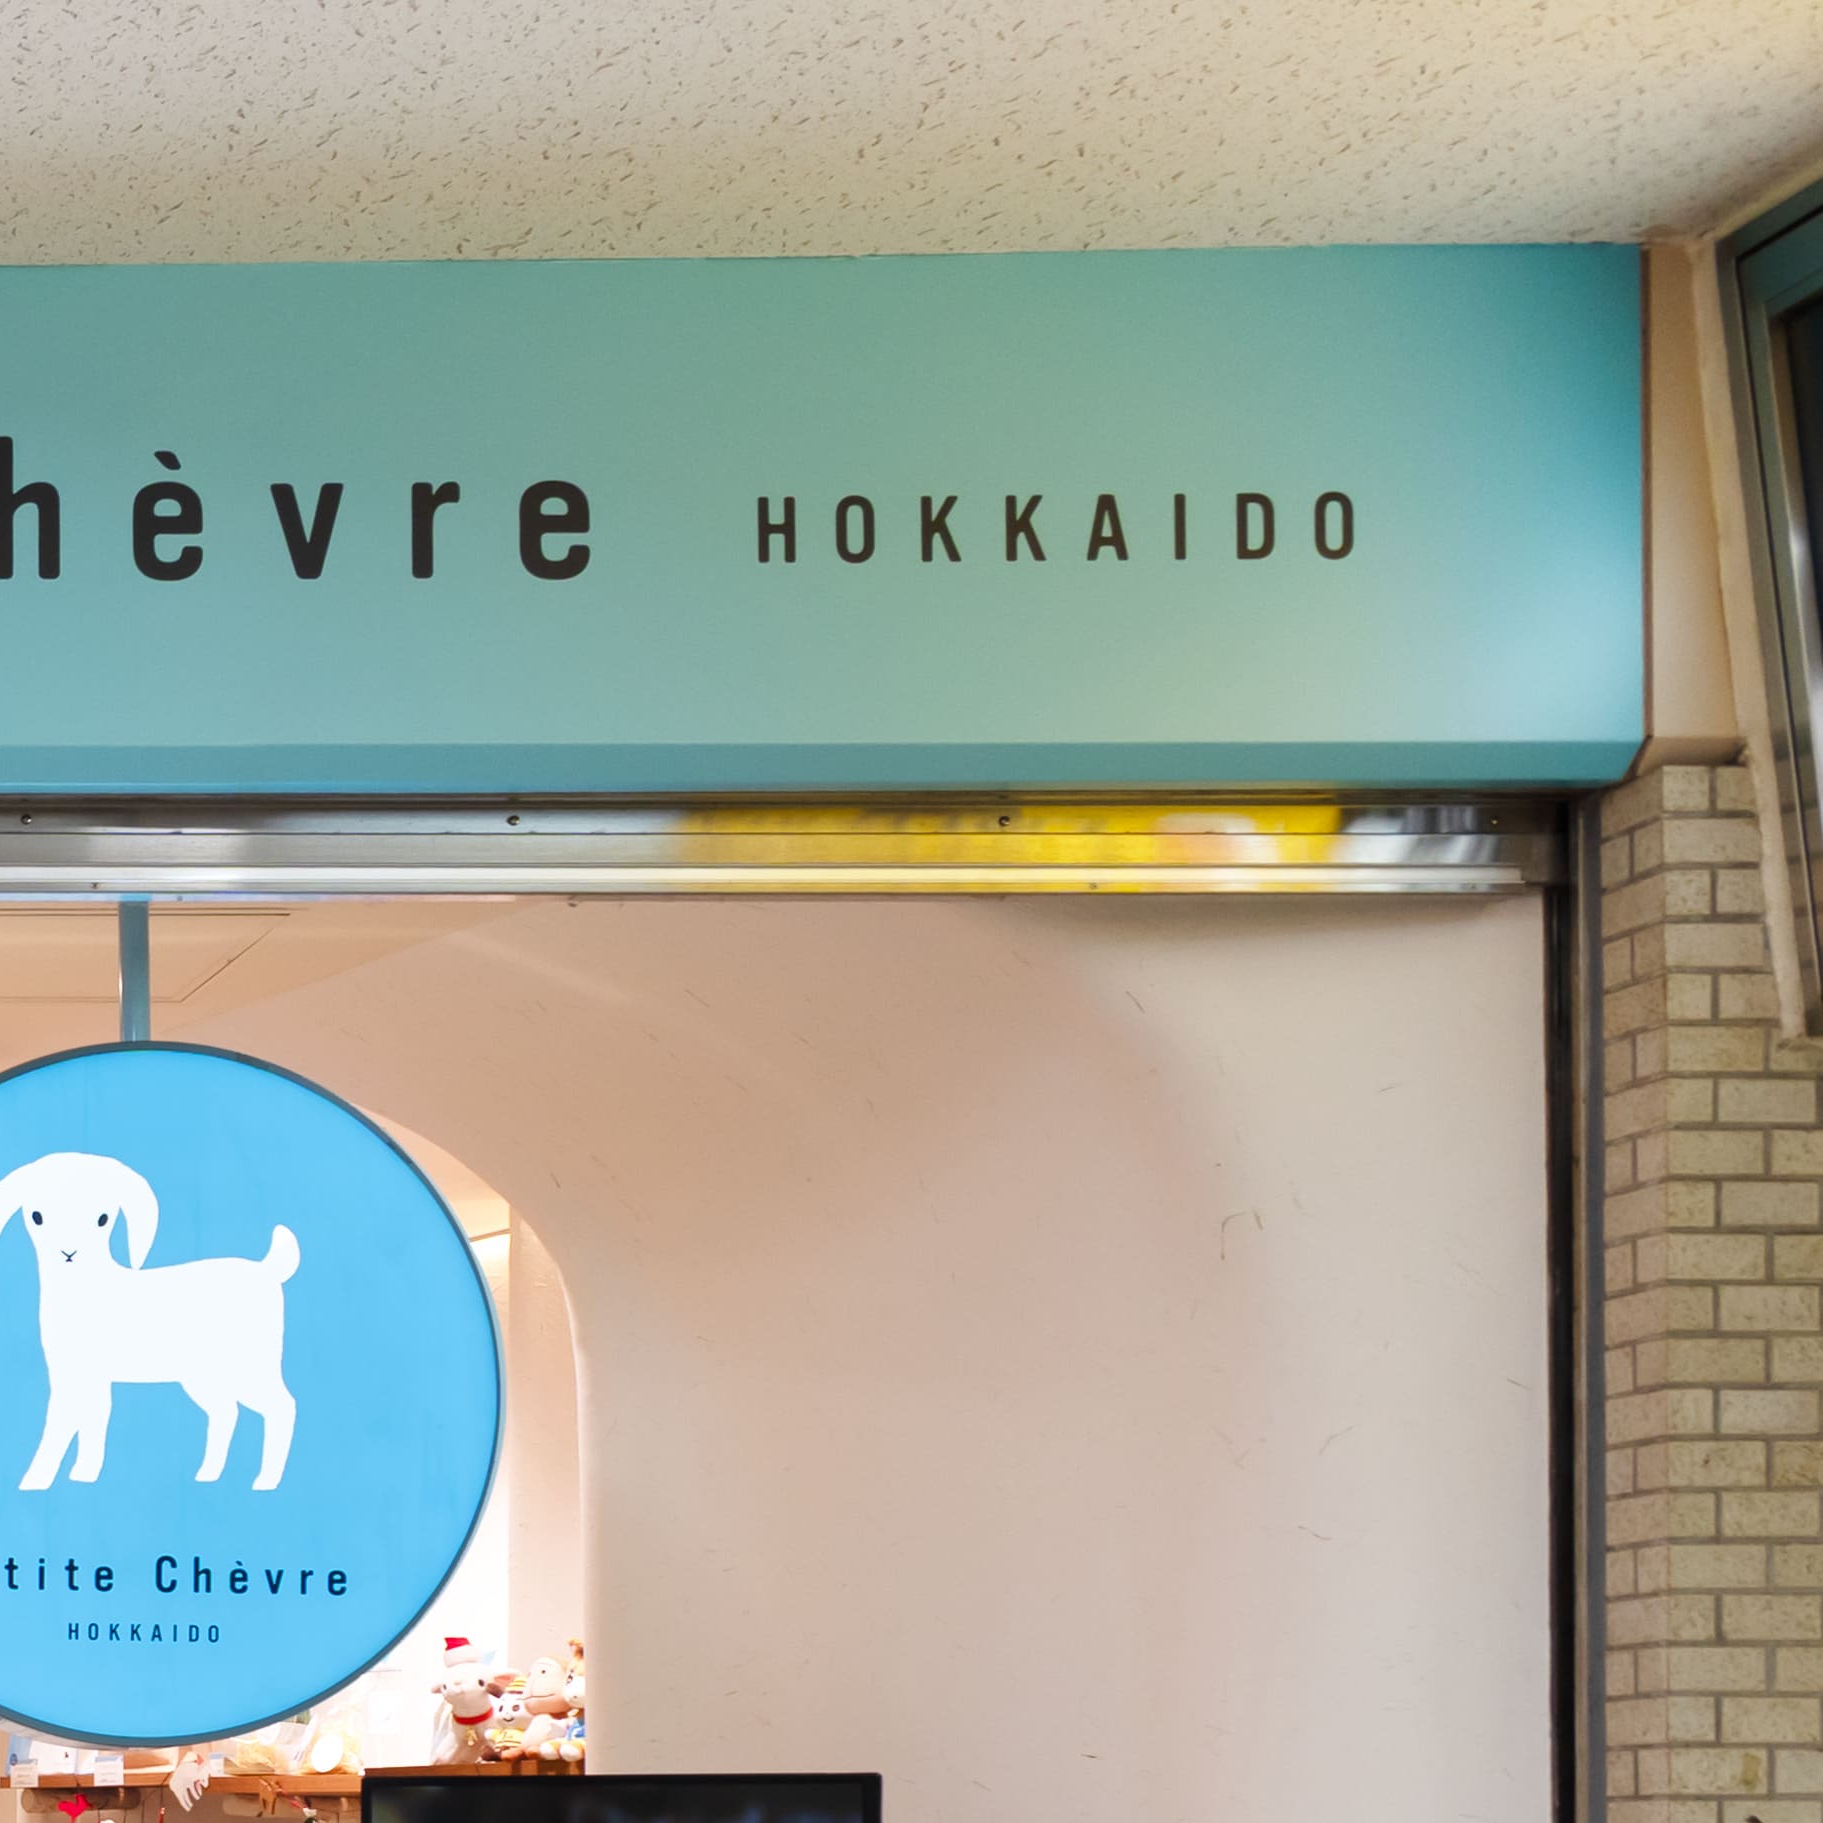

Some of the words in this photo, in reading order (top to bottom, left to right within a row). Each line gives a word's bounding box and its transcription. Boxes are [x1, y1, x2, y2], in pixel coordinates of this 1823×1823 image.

[757, 490, 1356, 564] HOKKAIDO
[155, 1555, 349, 1597] Chèvre
[67, 1622, 221, 1644] HOKKAIDO
